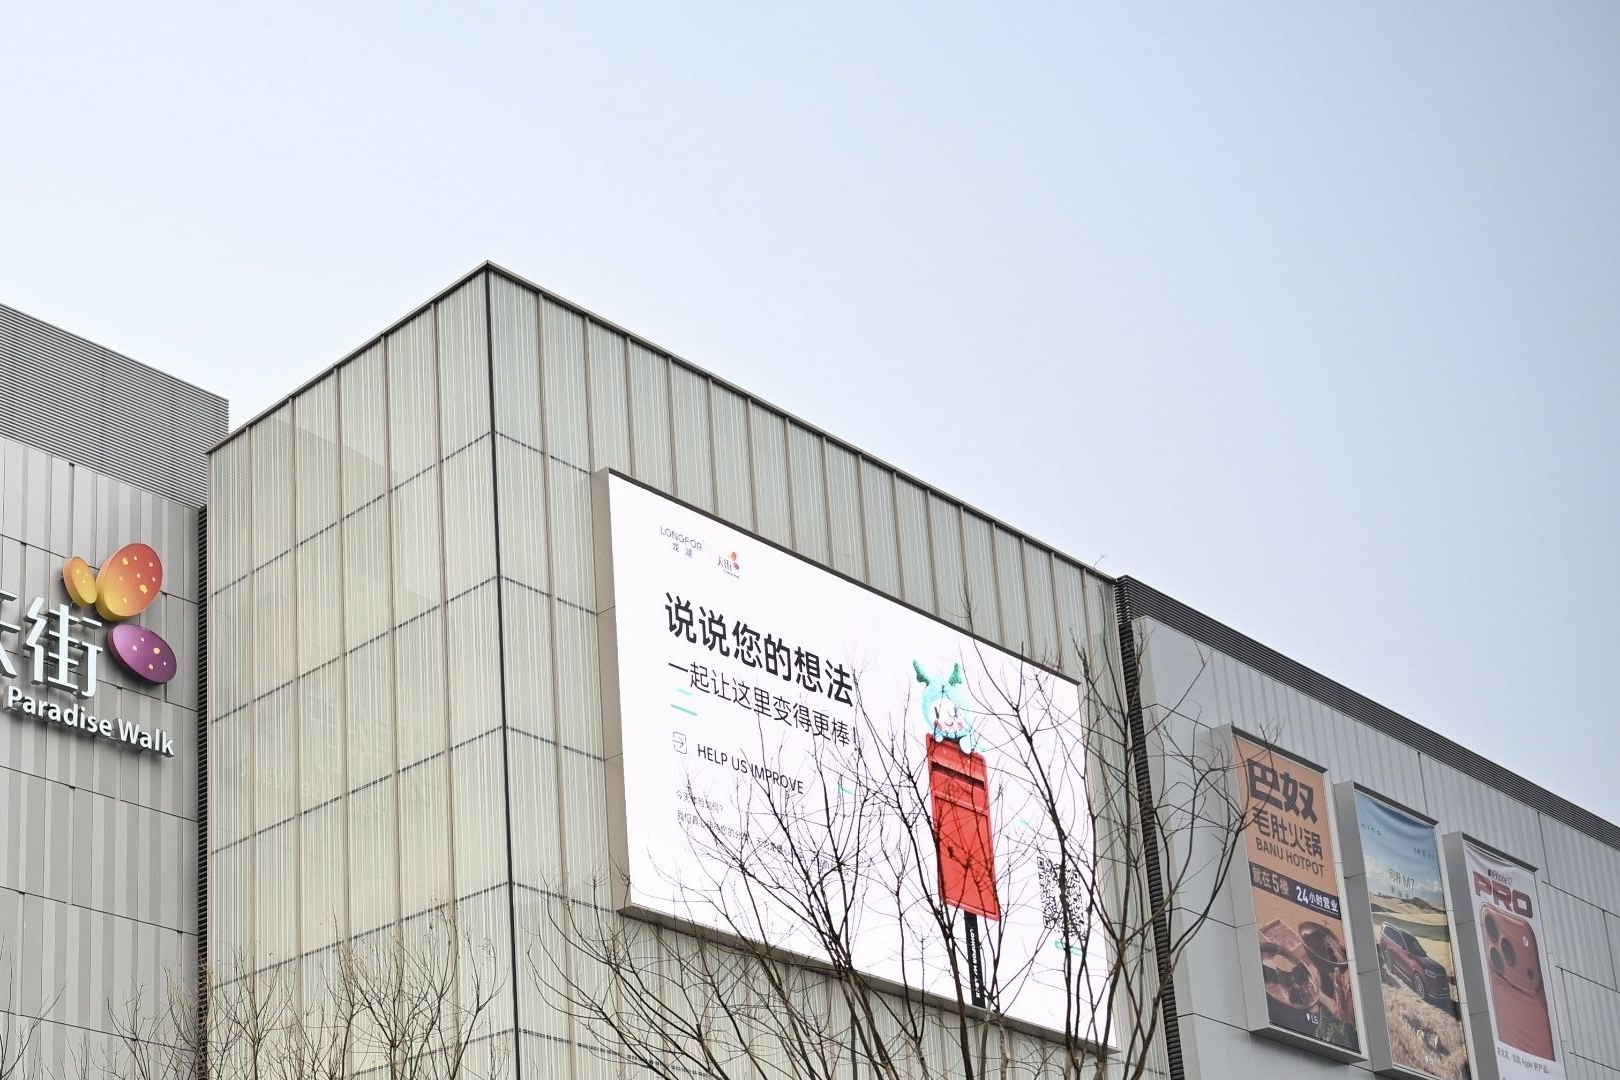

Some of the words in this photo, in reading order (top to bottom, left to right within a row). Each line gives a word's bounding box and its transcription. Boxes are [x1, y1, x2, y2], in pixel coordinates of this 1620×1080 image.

[660, 526, 703, 551] LONGFOR
[665, 592, 854, 707] 说说您的想法
[5, 685, 112, 738] Paradise
[116, 718, 175, 757] Walk
[697, 743, 728, 766] HELP
[731, 755, 748, 774] US
[750, 763, 804, 795] IMPROVE
[1247, 758, 1318, 824] 巴奴
[1252, 806, 1323, 860] 毛肚火锅
[1256, 837, 1283, 860] BANU
[1286, 850, 1325, 877] HOTPOT
[1252, 866, 1290, 896] 就在5楼
[1296, 885, 1339, 912] 24小时营业
[1403, 874, 1415, 891] M7
[1472, 870, 1534, 919] PRO
